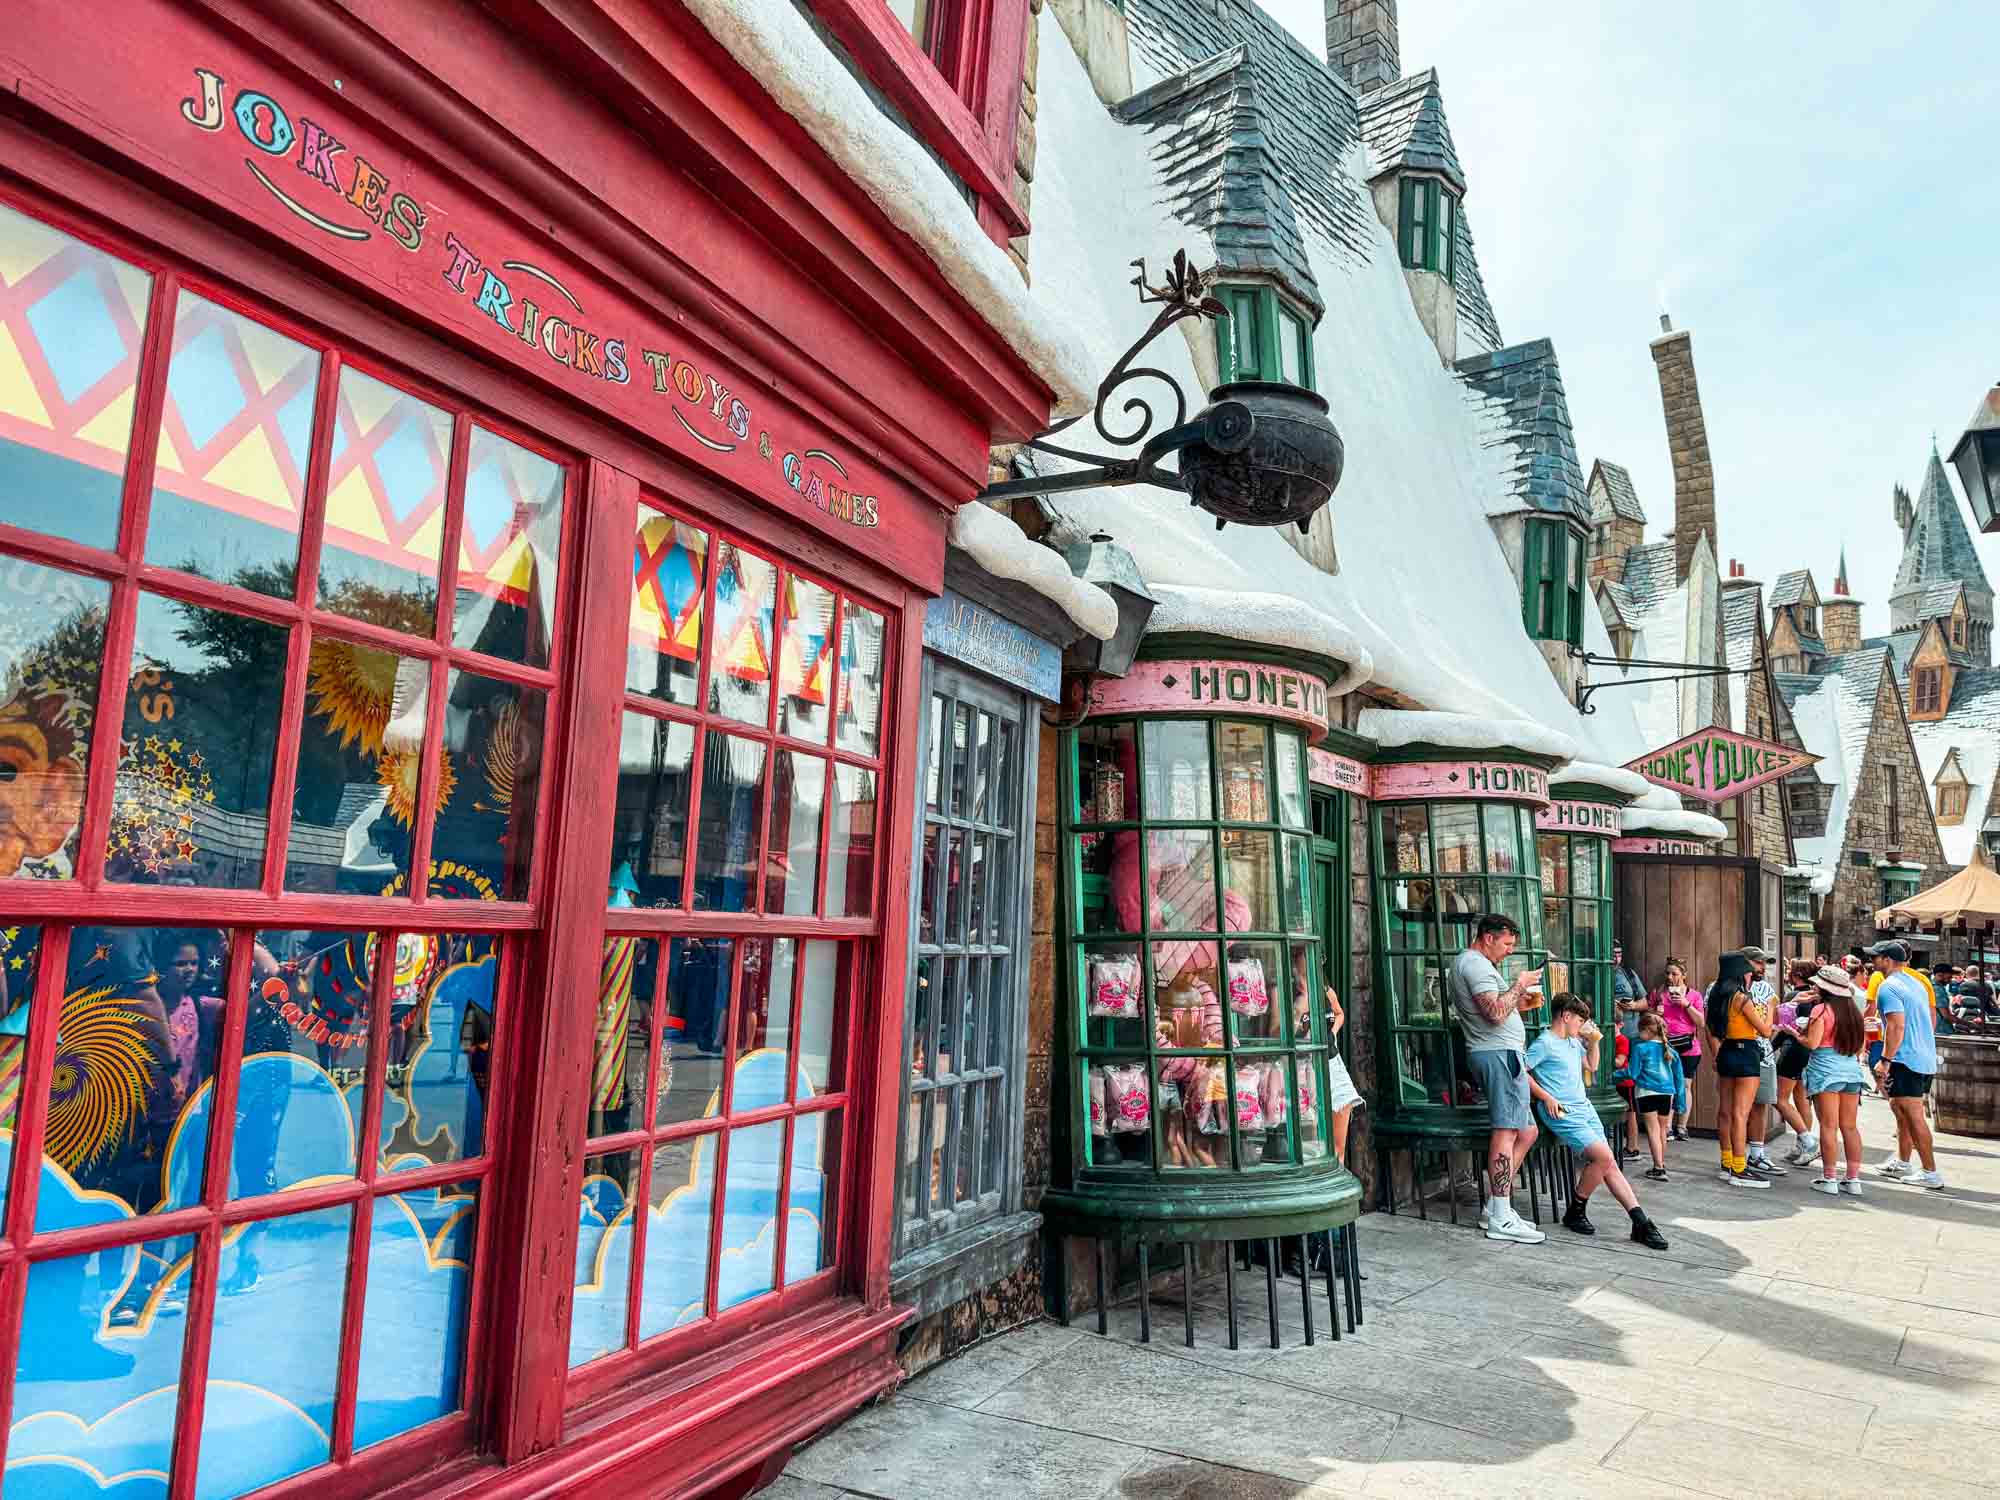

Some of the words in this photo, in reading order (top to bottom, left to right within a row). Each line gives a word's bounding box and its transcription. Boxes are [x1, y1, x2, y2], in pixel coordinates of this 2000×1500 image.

[180, 67, 429, 252] JOKES
[442, 231, 632, 385] TRICKS
[641, 347, 752, 440] TOYS
[757, 430, 774, 461] &
[782, 452, 880, 528] GAMES
[1640, 736, 1792, 791] HONEYDUKES
